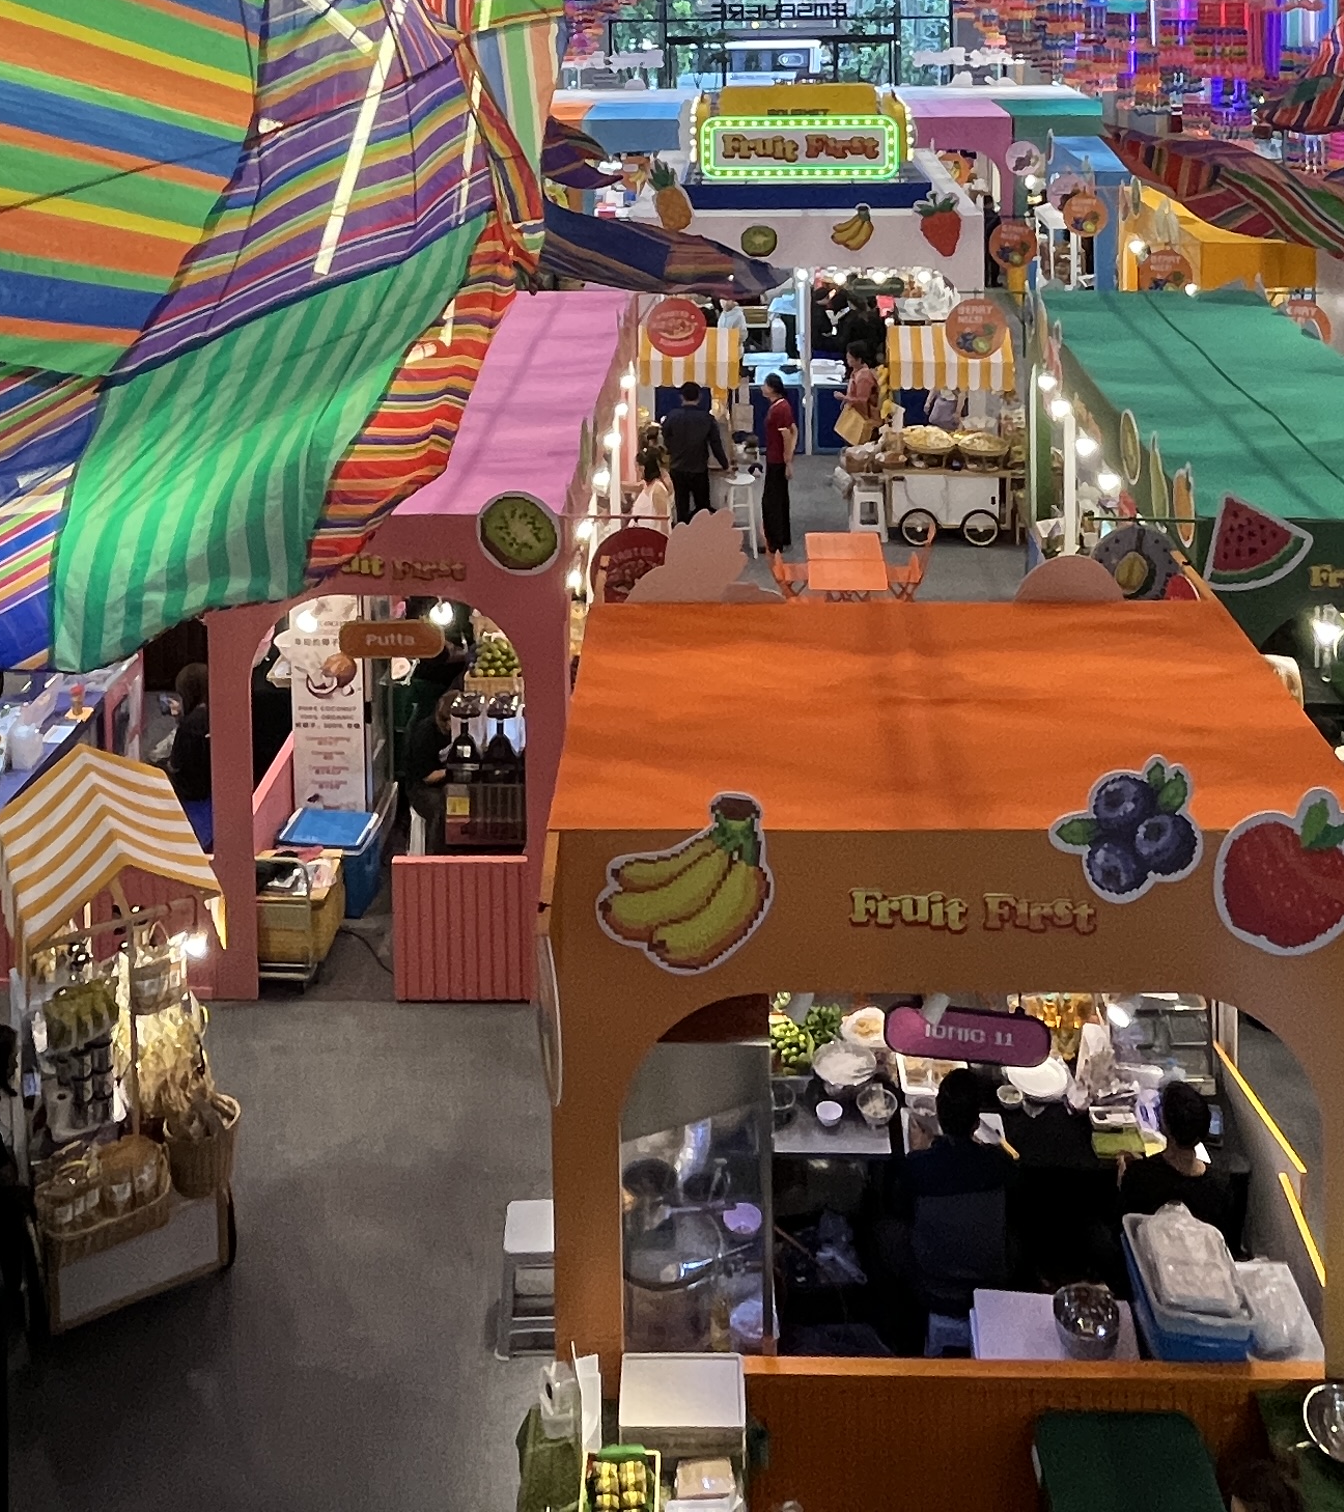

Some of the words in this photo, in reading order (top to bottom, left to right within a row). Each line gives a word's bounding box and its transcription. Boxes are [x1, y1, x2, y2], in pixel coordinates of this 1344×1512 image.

[722, 134, 799, 163] Fruit
[805, 134, 880, 159] First
[365, 632, 416, 647] Putta
[848, 887, 968, 936] Fruit
[982, 892, 1097, 936] First
